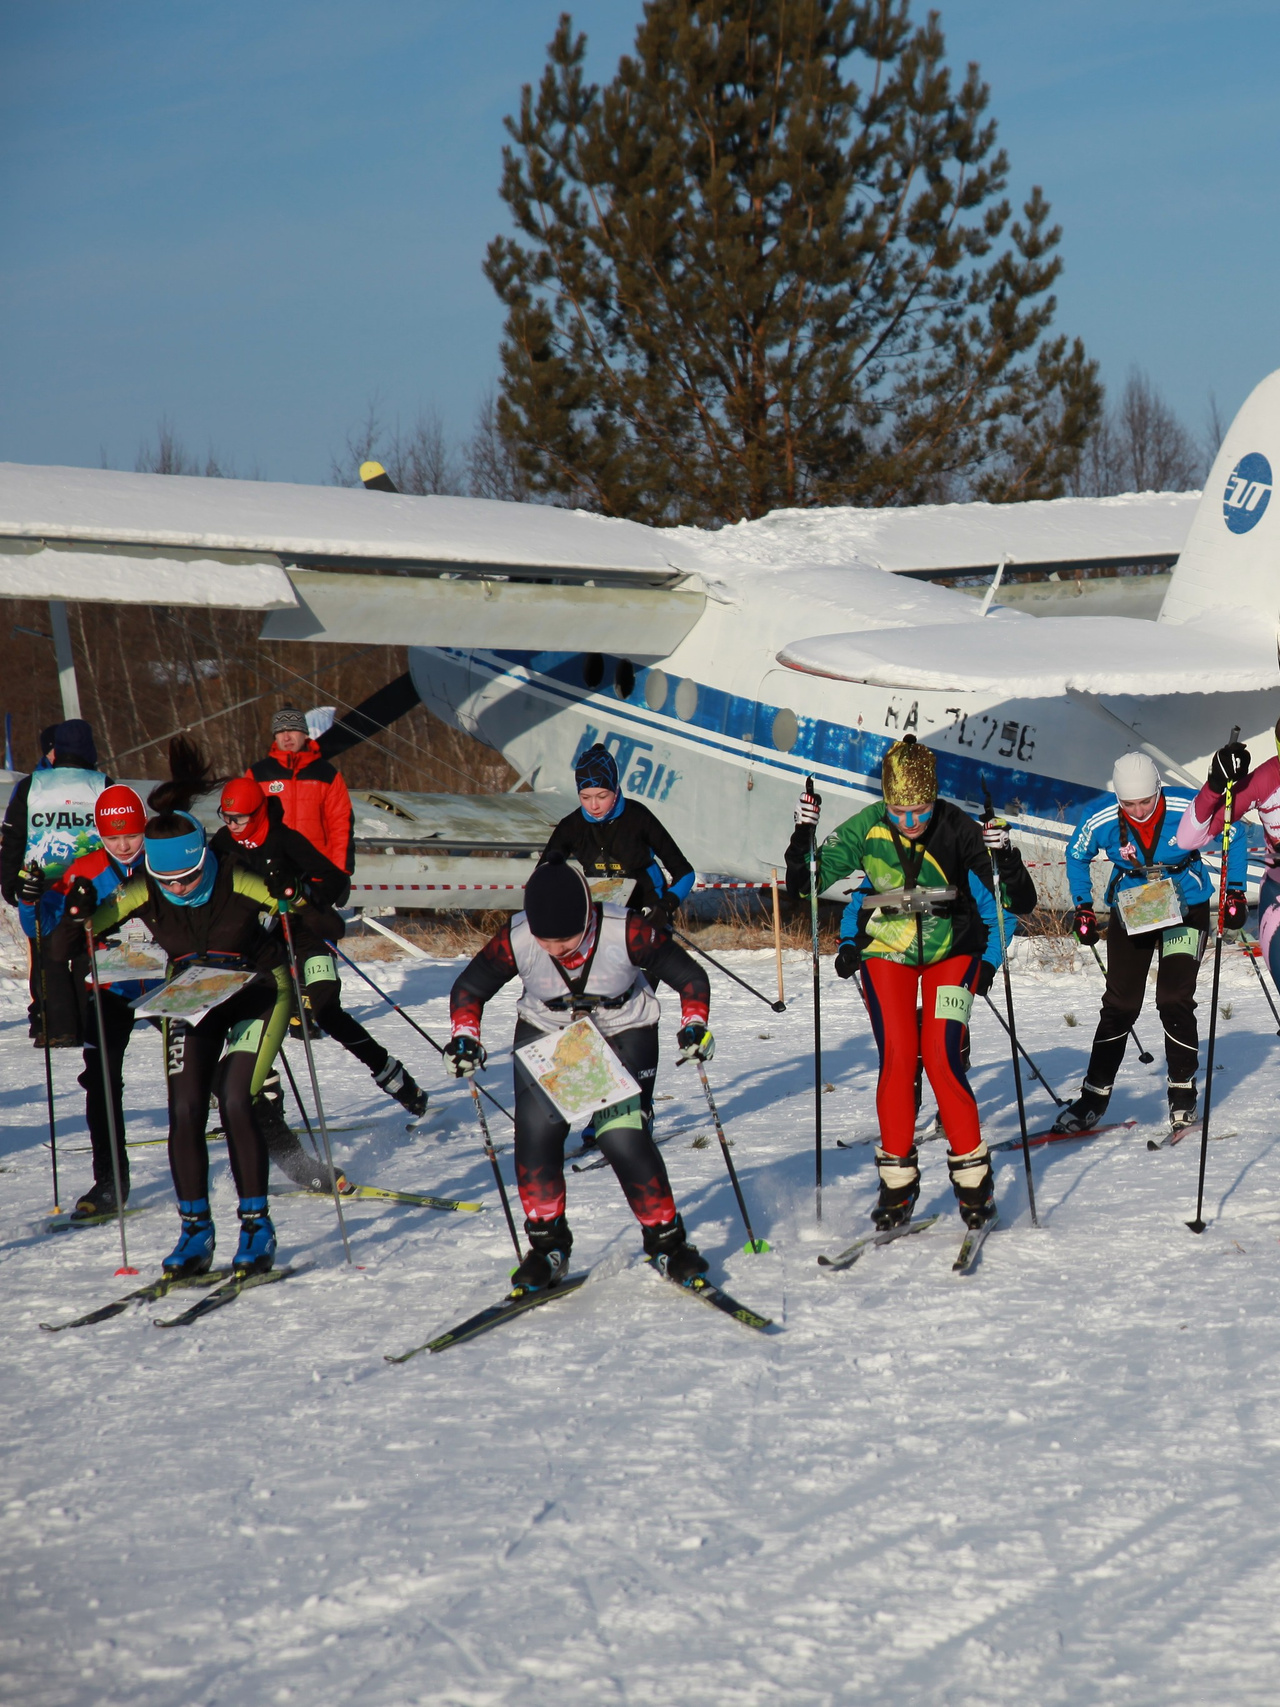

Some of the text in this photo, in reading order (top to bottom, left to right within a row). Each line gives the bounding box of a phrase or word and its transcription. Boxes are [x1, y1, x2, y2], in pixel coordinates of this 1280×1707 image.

[100, 806, 135, 816] LUKOIL
[31, 812, 97, 829] СУДЬЯ
[1166, 936, 1192, 948] 309.1
[307, 965, 330, 977] 312.1
